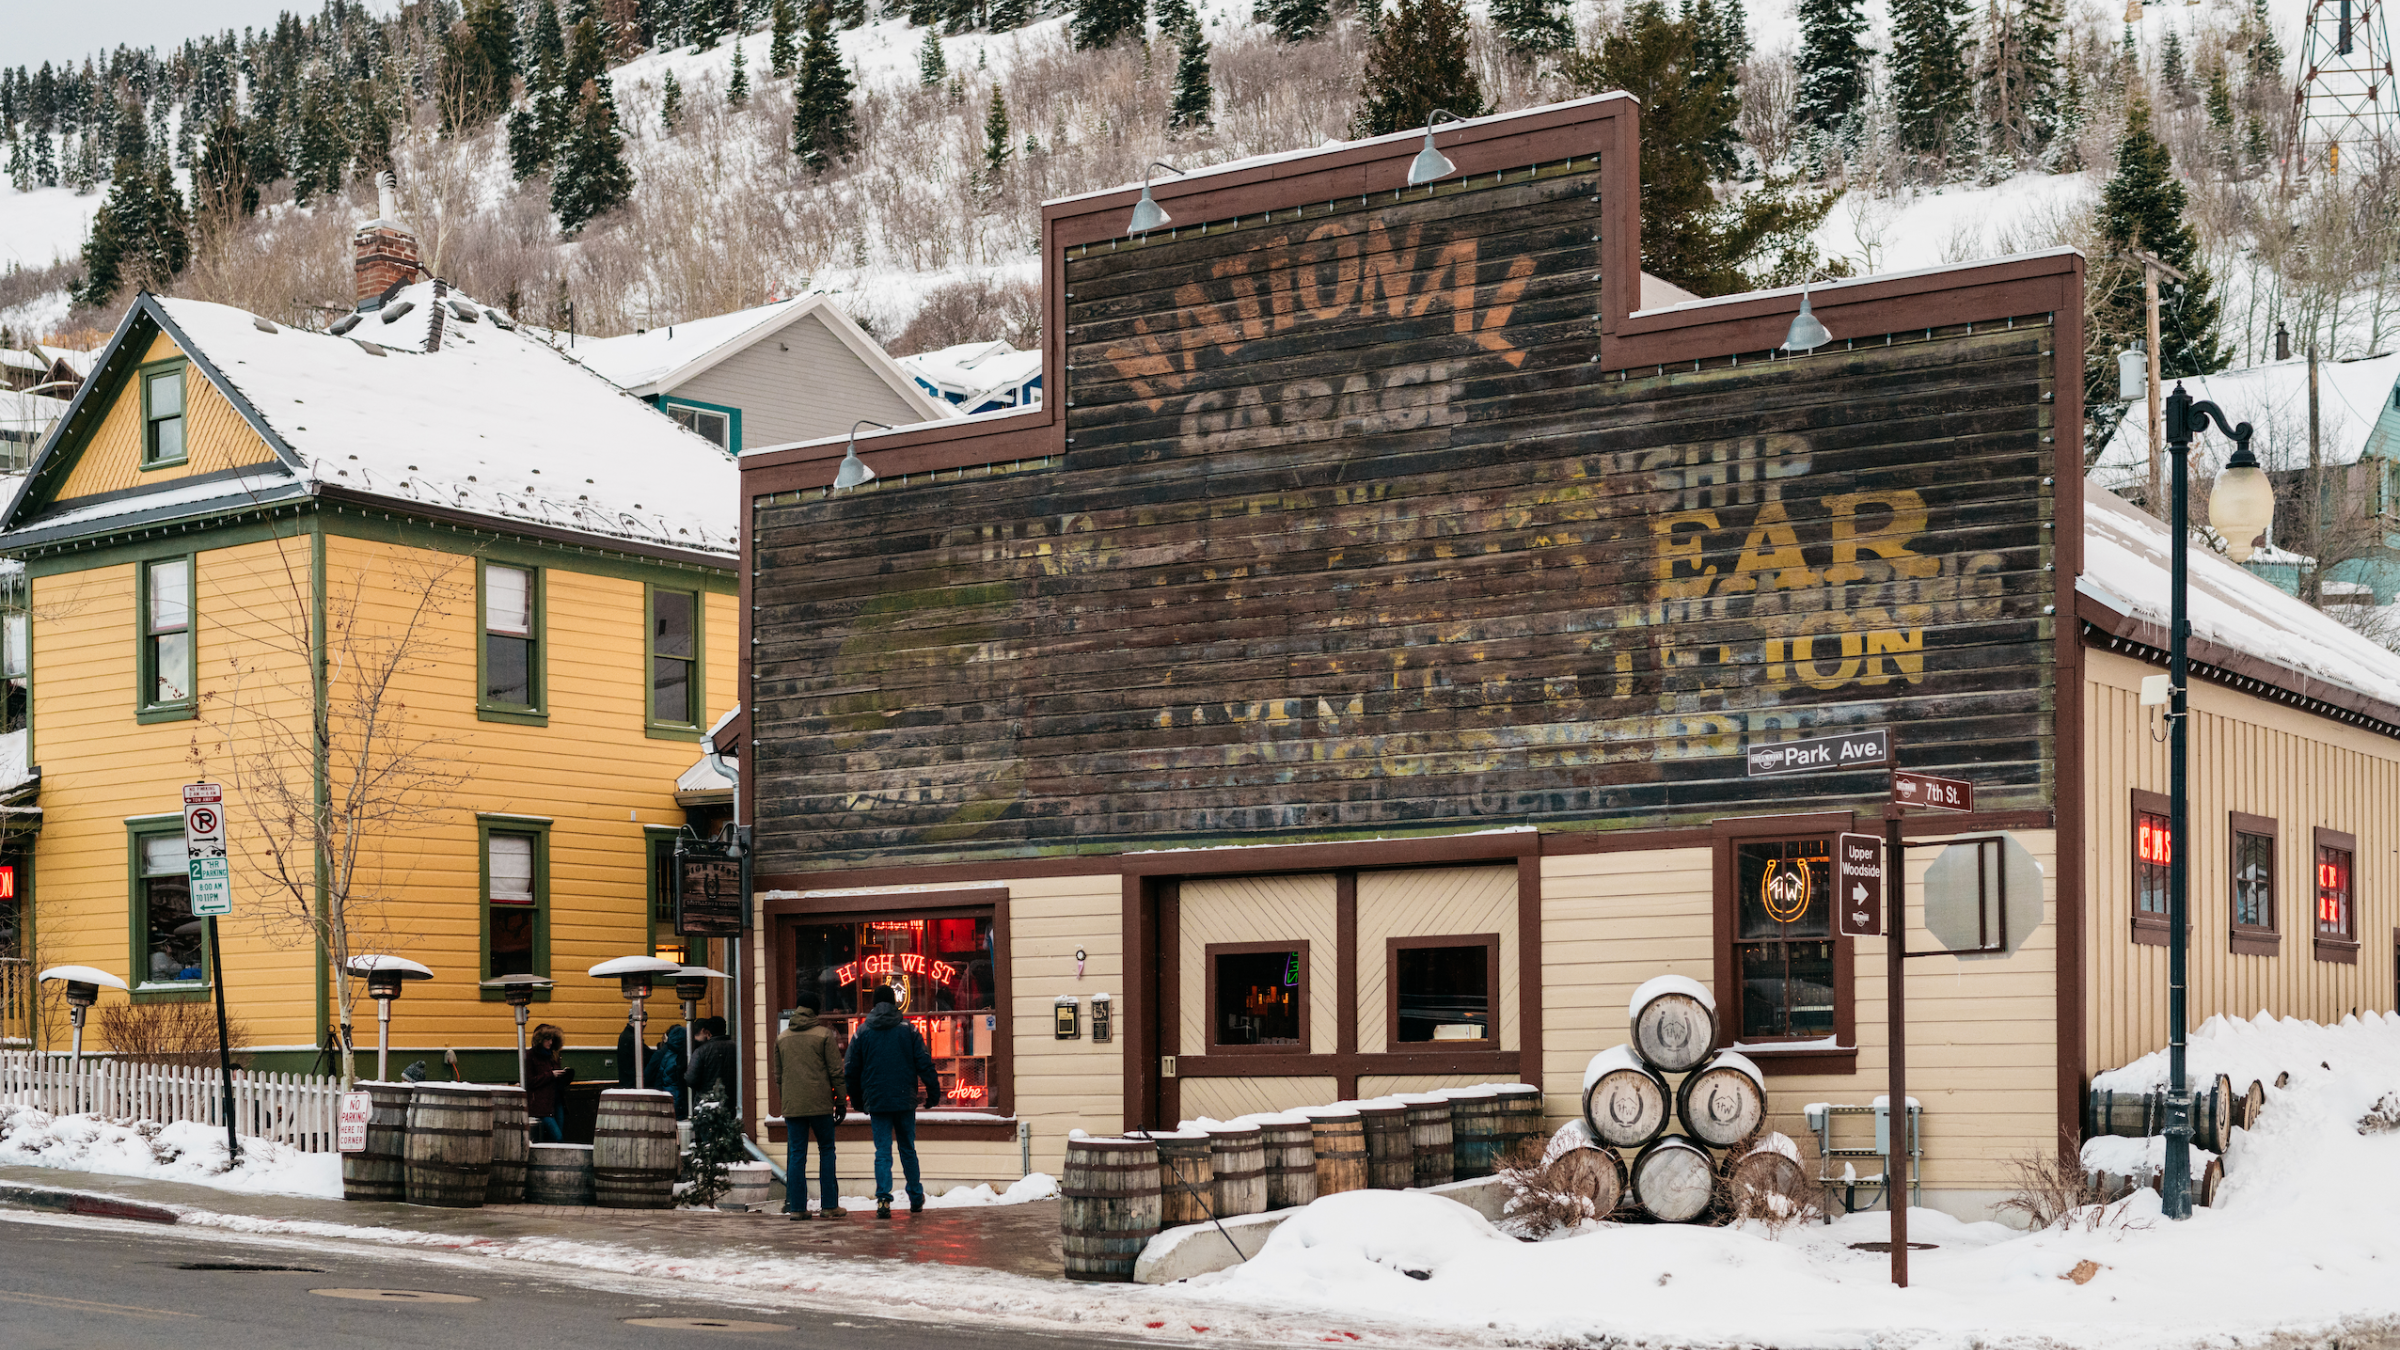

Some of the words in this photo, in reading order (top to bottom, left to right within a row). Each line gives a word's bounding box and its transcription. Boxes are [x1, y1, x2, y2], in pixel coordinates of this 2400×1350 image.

[1105, 220, 1538, 413] NATIONAL
[1785, 744, 1831, 766] Park
[1839, 741, 1883, 760] Ave.
[1925, 783, 1943, 801] 7th
[1946, 785, 1960, 804] St.
[1848, 845, 1874, 861] Upper
[192, 863, 201, 878] 2
[202, 869, 227, 877] PARKING
[1842, 862, 1880, 877] Woodside
[199, 883, 213, 891] 8:00
[947, 1077, 983, 1099] Here
[350, 1099, 360, 1110] NO
[341, 1112, 365, 1123] PARKING
[341, 1126, 355, 1134] HERE
